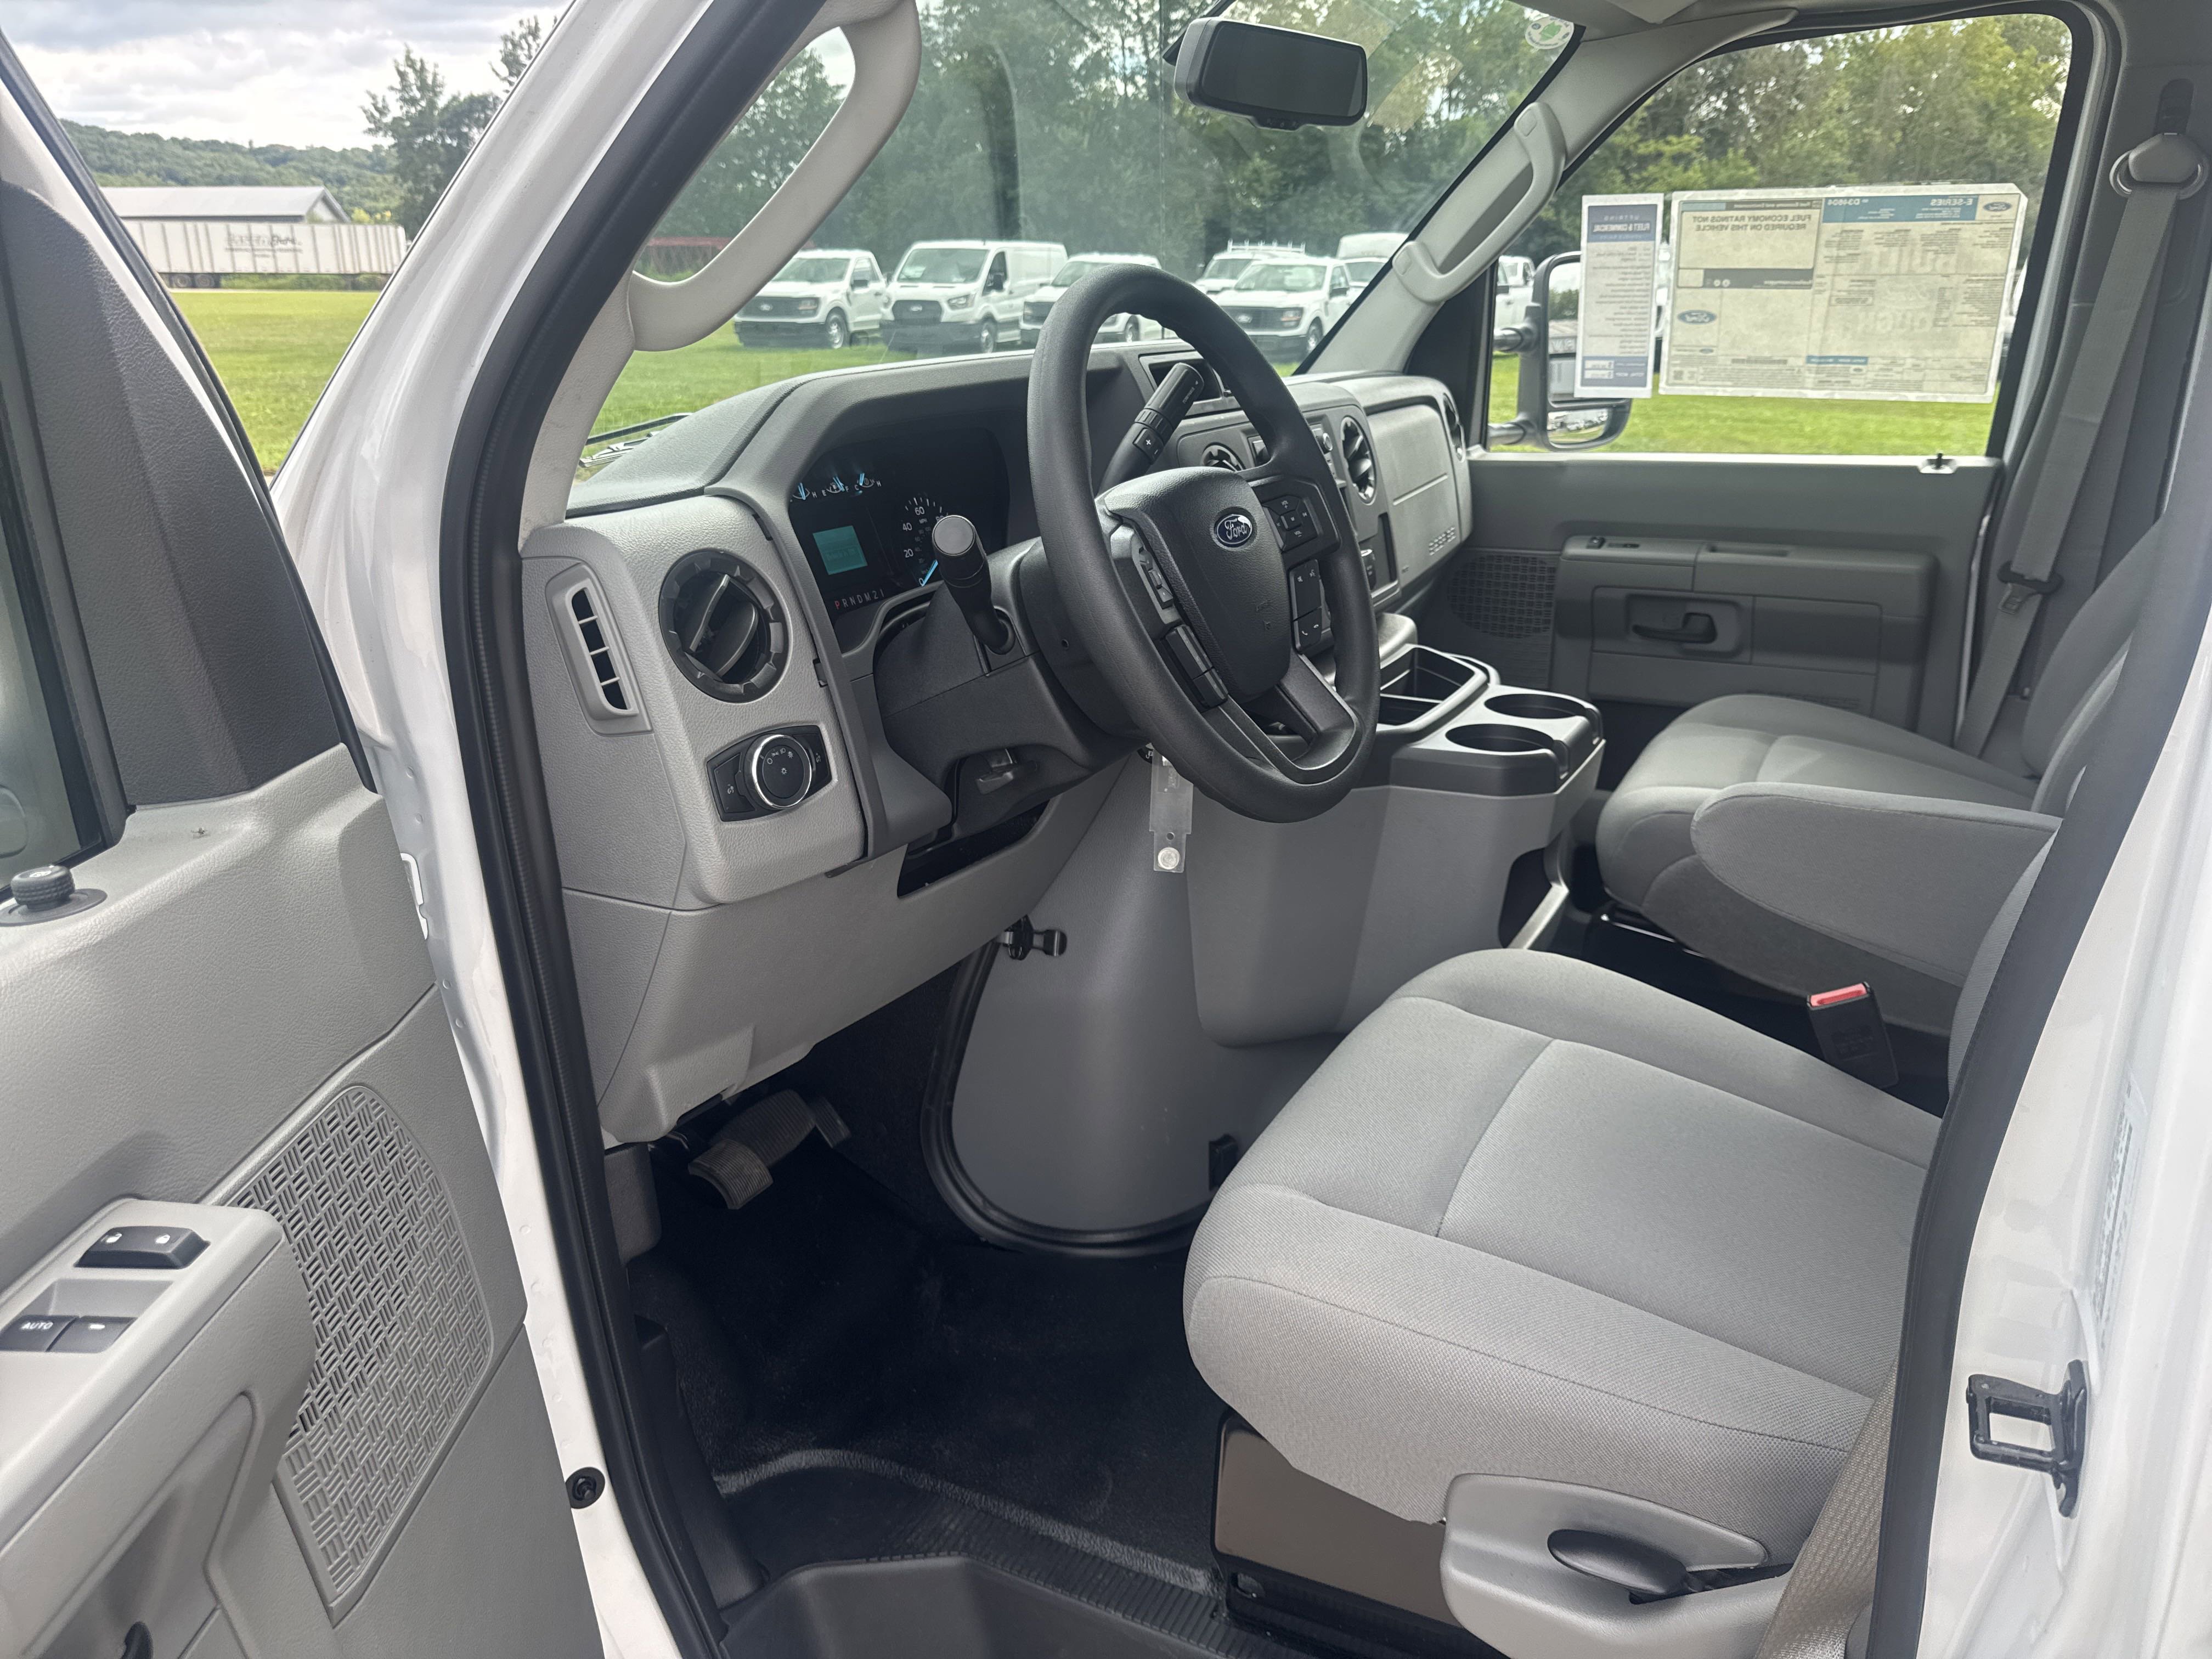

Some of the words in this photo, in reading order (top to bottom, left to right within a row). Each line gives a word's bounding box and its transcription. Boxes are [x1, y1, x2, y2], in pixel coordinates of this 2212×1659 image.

[915, 506, 926, 516] 60
[902, 522, 913, 532] 40
[1224, 517, 1248, 540] Ford
[904, 548, 914, 558] 20
[21, 1322, 54, 1330] AUTO
